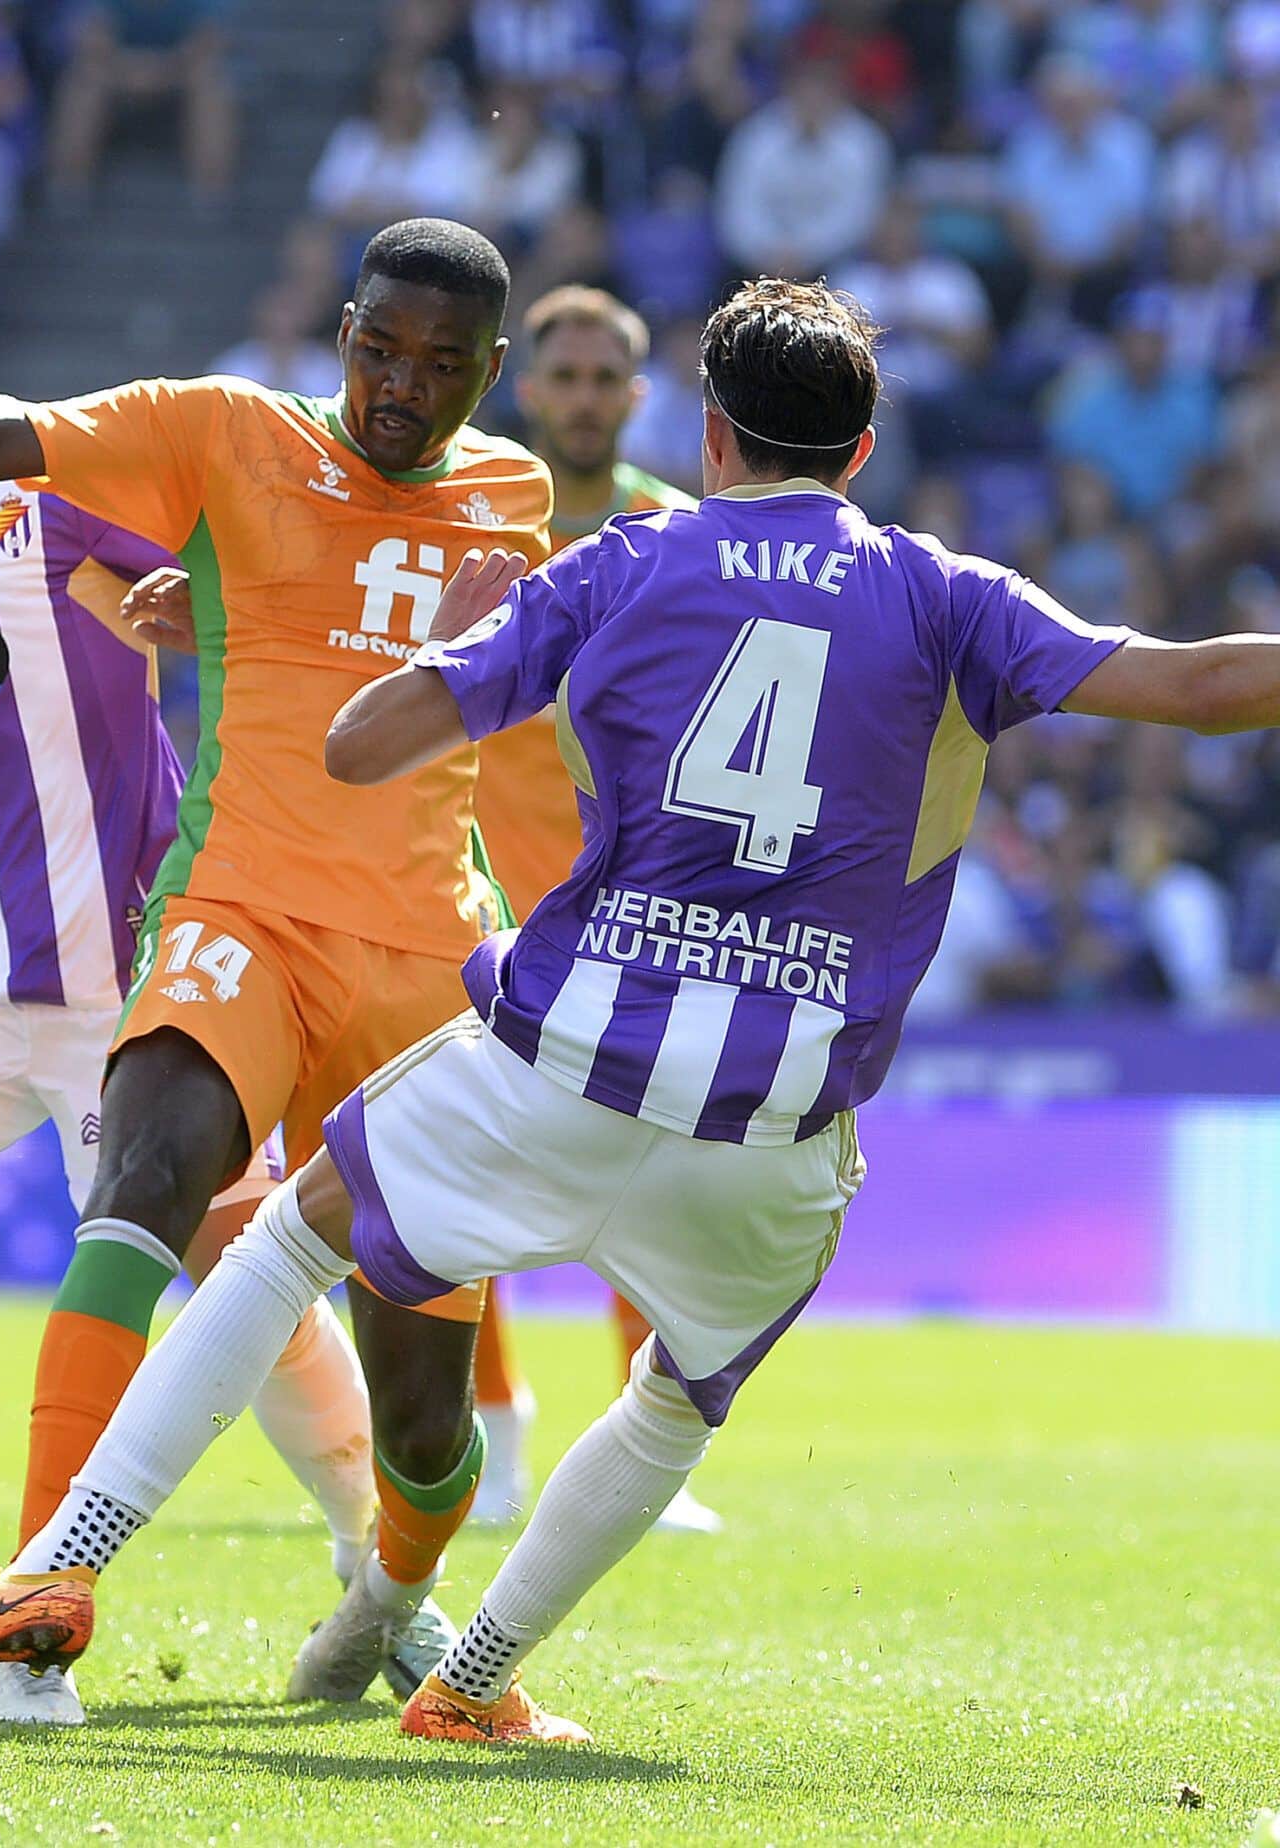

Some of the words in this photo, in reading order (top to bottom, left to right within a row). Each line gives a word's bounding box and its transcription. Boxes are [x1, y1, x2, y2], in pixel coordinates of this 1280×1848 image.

[354, 537, 444, 643] fi
[717, 539, 855, 595] KIKE
[660, 617, 832, 875] 4
[165, 921, 253, 1004] 14
[575, 922, 847, 1006] NUTRITION
[590, 887, 853, 970] HERBALIFE
